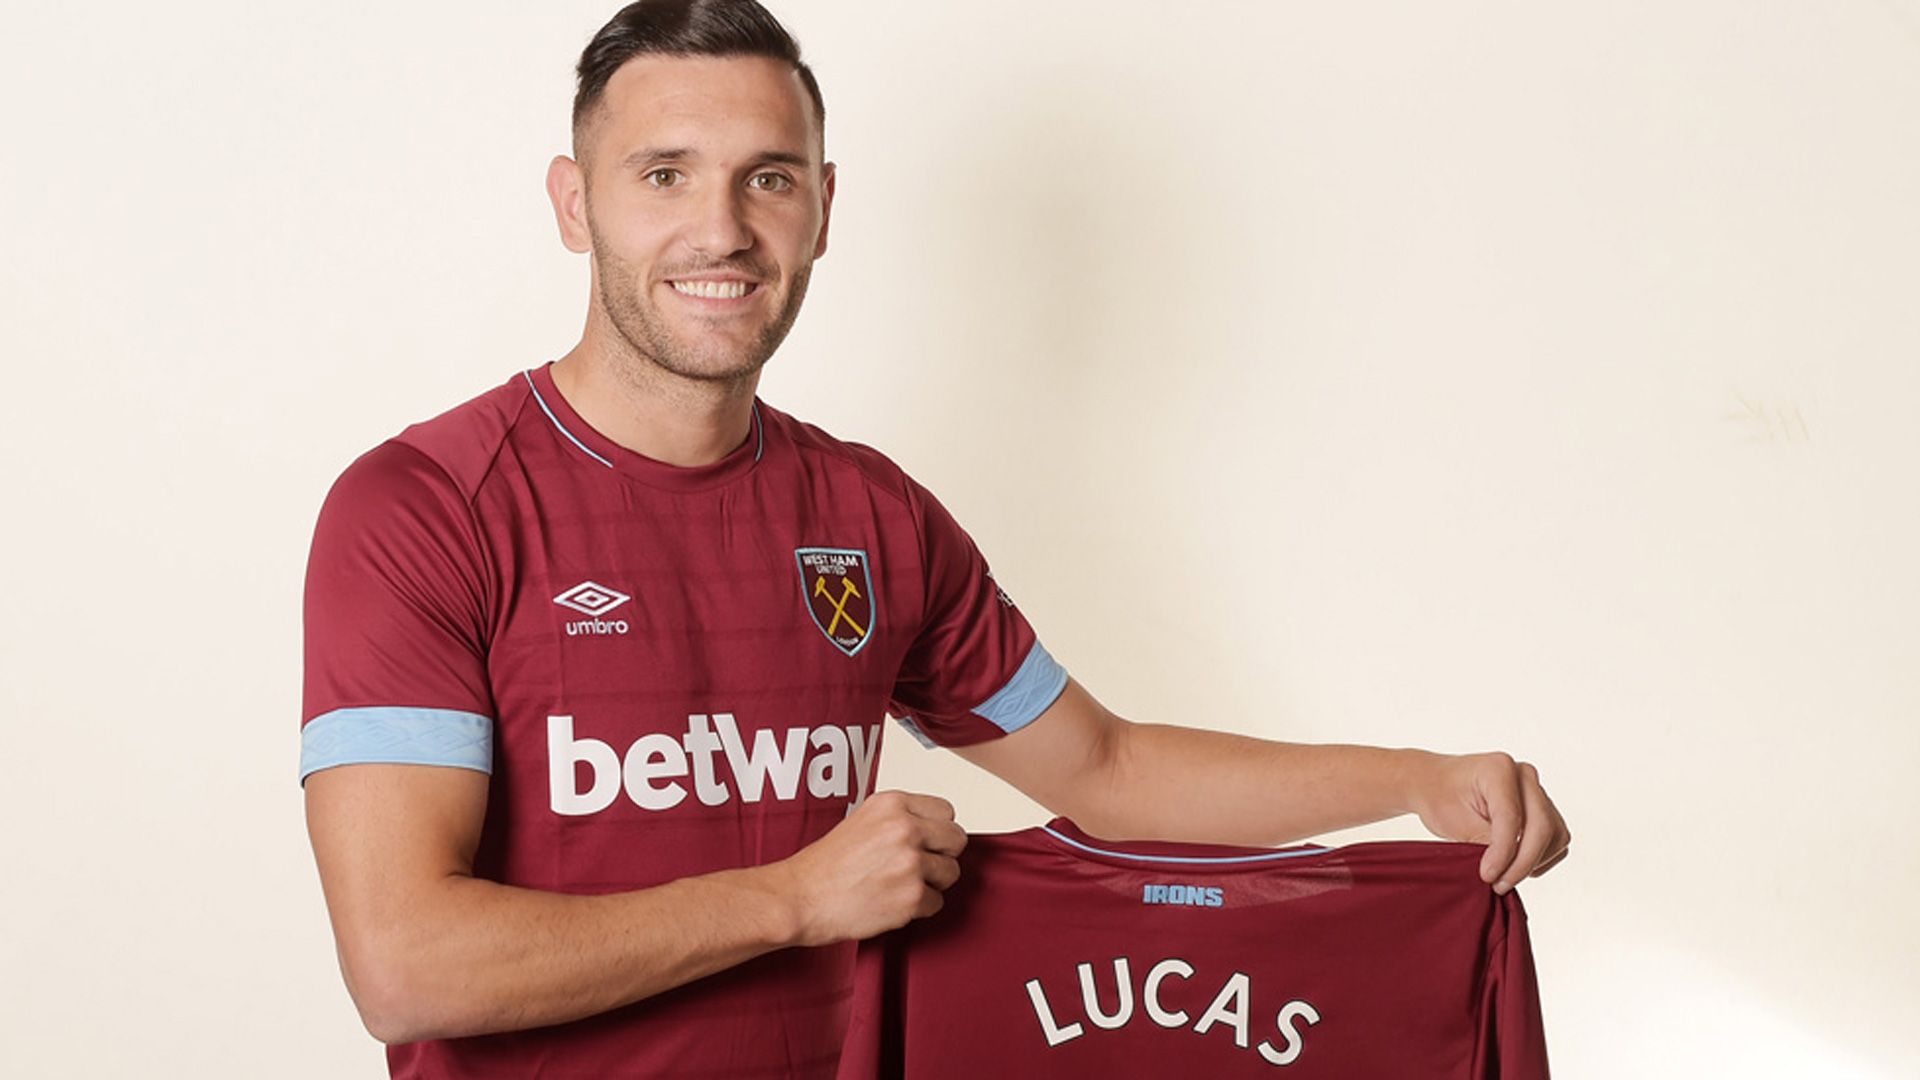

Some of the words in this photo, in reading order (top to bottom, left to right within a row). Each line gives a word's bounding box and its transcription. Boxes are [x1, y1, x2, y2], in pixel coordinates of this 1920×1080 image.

[802, 554, 828, 566] WEST
[829, 555, 859, 567] HAM
[566, 618, 628, 636] umbro
[547, 713, 880, 816] betway
[1143, 884, 1223, 906] IRONS
[1025, 957, 1321, 1066] LUCAS
